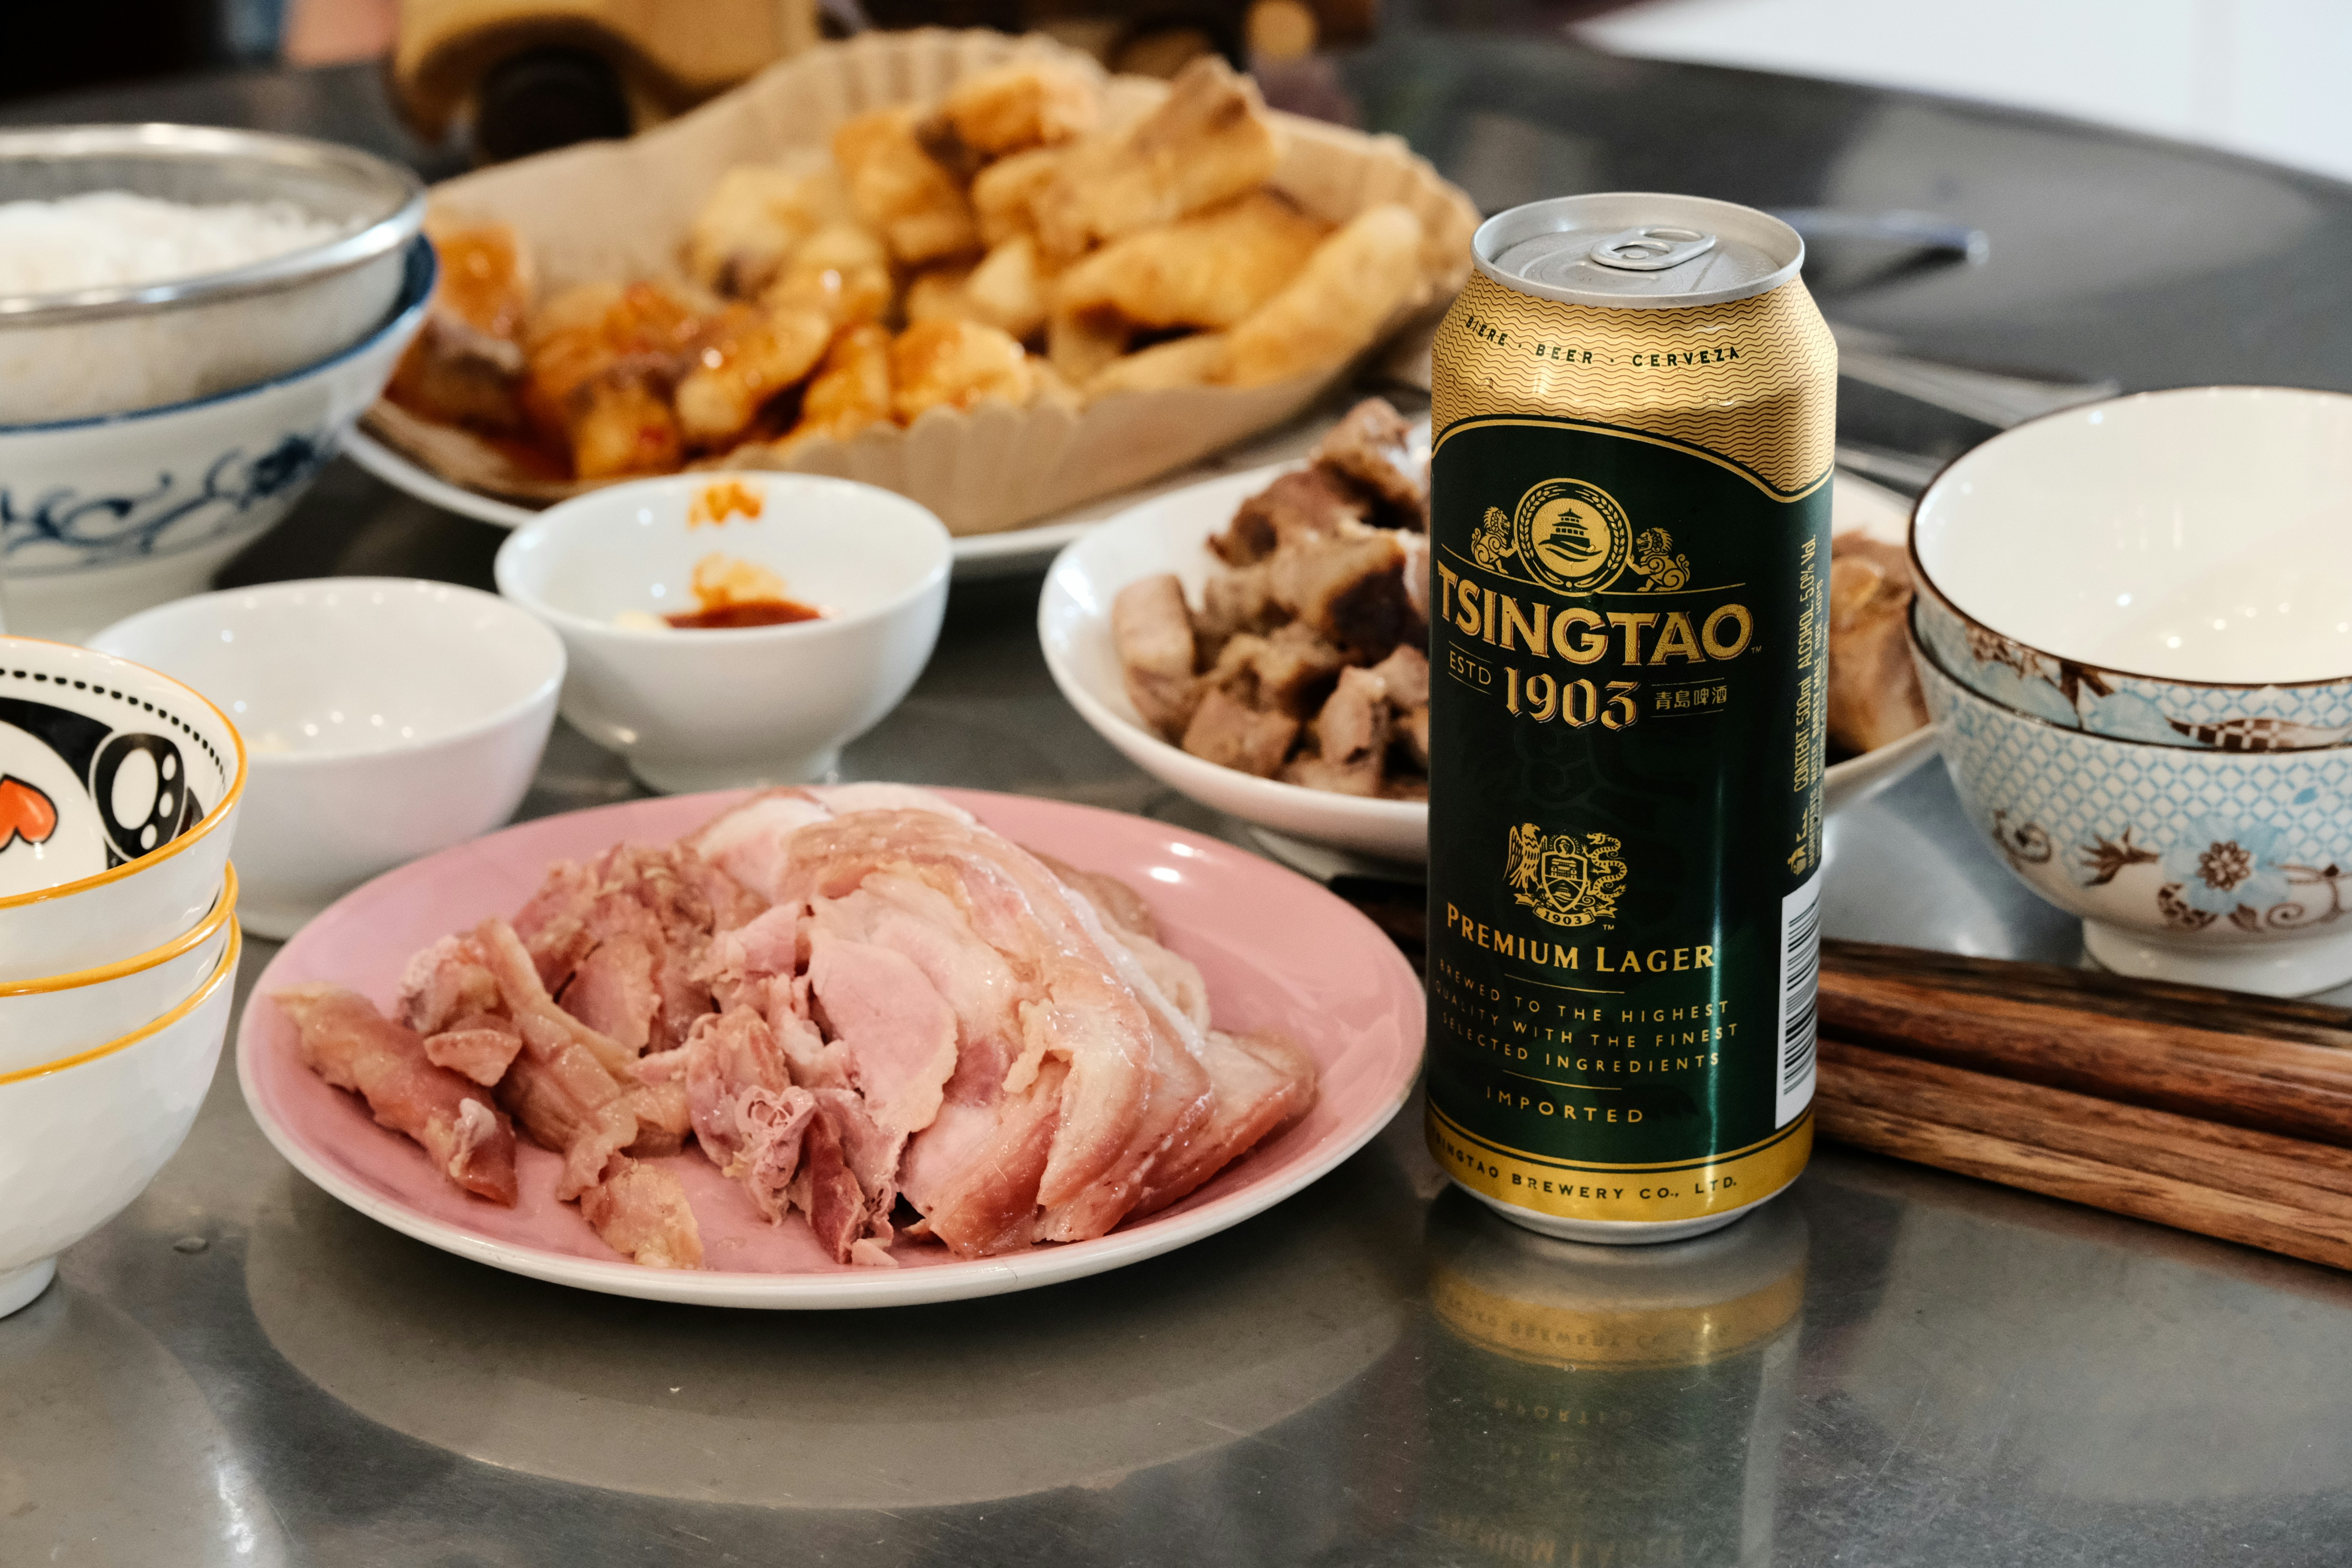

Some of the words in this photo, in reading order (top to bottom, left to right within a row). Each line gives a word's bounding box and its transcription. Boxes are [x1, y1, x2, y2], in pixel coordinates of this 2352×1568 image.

[1466, 315, 1508, 346] BIERE
[1535, 343, 1593, 364] BEER
[1632, 346, 1740, 367] CERVEZA
[1801, 534, 1816, 565] Vol.
[1800, 563, 1815, 602] 5.0%
[1437, 559, 1754, 666] TSINGTAO
[1449, 651, 1491, 685] ESTD
[1504, 666, 1642, 732] 1903
[1654, 685, 1727, 710] 青島啤酒
[1796, 676, 1811, 726] 500ml
[1447, 902, 1579, 969] PREMIUM
[1596, 945, 1715, 972] LAGER
[1545, 910, 1582, 925] 1903
[1435, 980, 1499, 1026] QUALITY
[1513, 1020, 1572, 1044] WITH
[1591, 1034, 1635, 1048] THE
[1656, 1023, 1737, 1047] FINEST
[1440, 958, 1500, 1001] BREWED
[1515, 996, 1540, 1012] TO
[1558, 1005, 1601, 1021] THE
[1622, 1000, 1728, 1022] HIGHEST
[1443, 1012, 1528, 1060] SELECTED
[1546, 1052, 1719, 1073] INGREDIENTS
[1487, 1086, 1643, 1123] IMPORTED
[1434, 1125, 1499, 1178] SINGTAO
[1512, 1173, 1623, 1199] BREWERY
[1639, 1187, 1679, 1199] CO.,
[1695, 1176, 1737, 1194] LTD.
